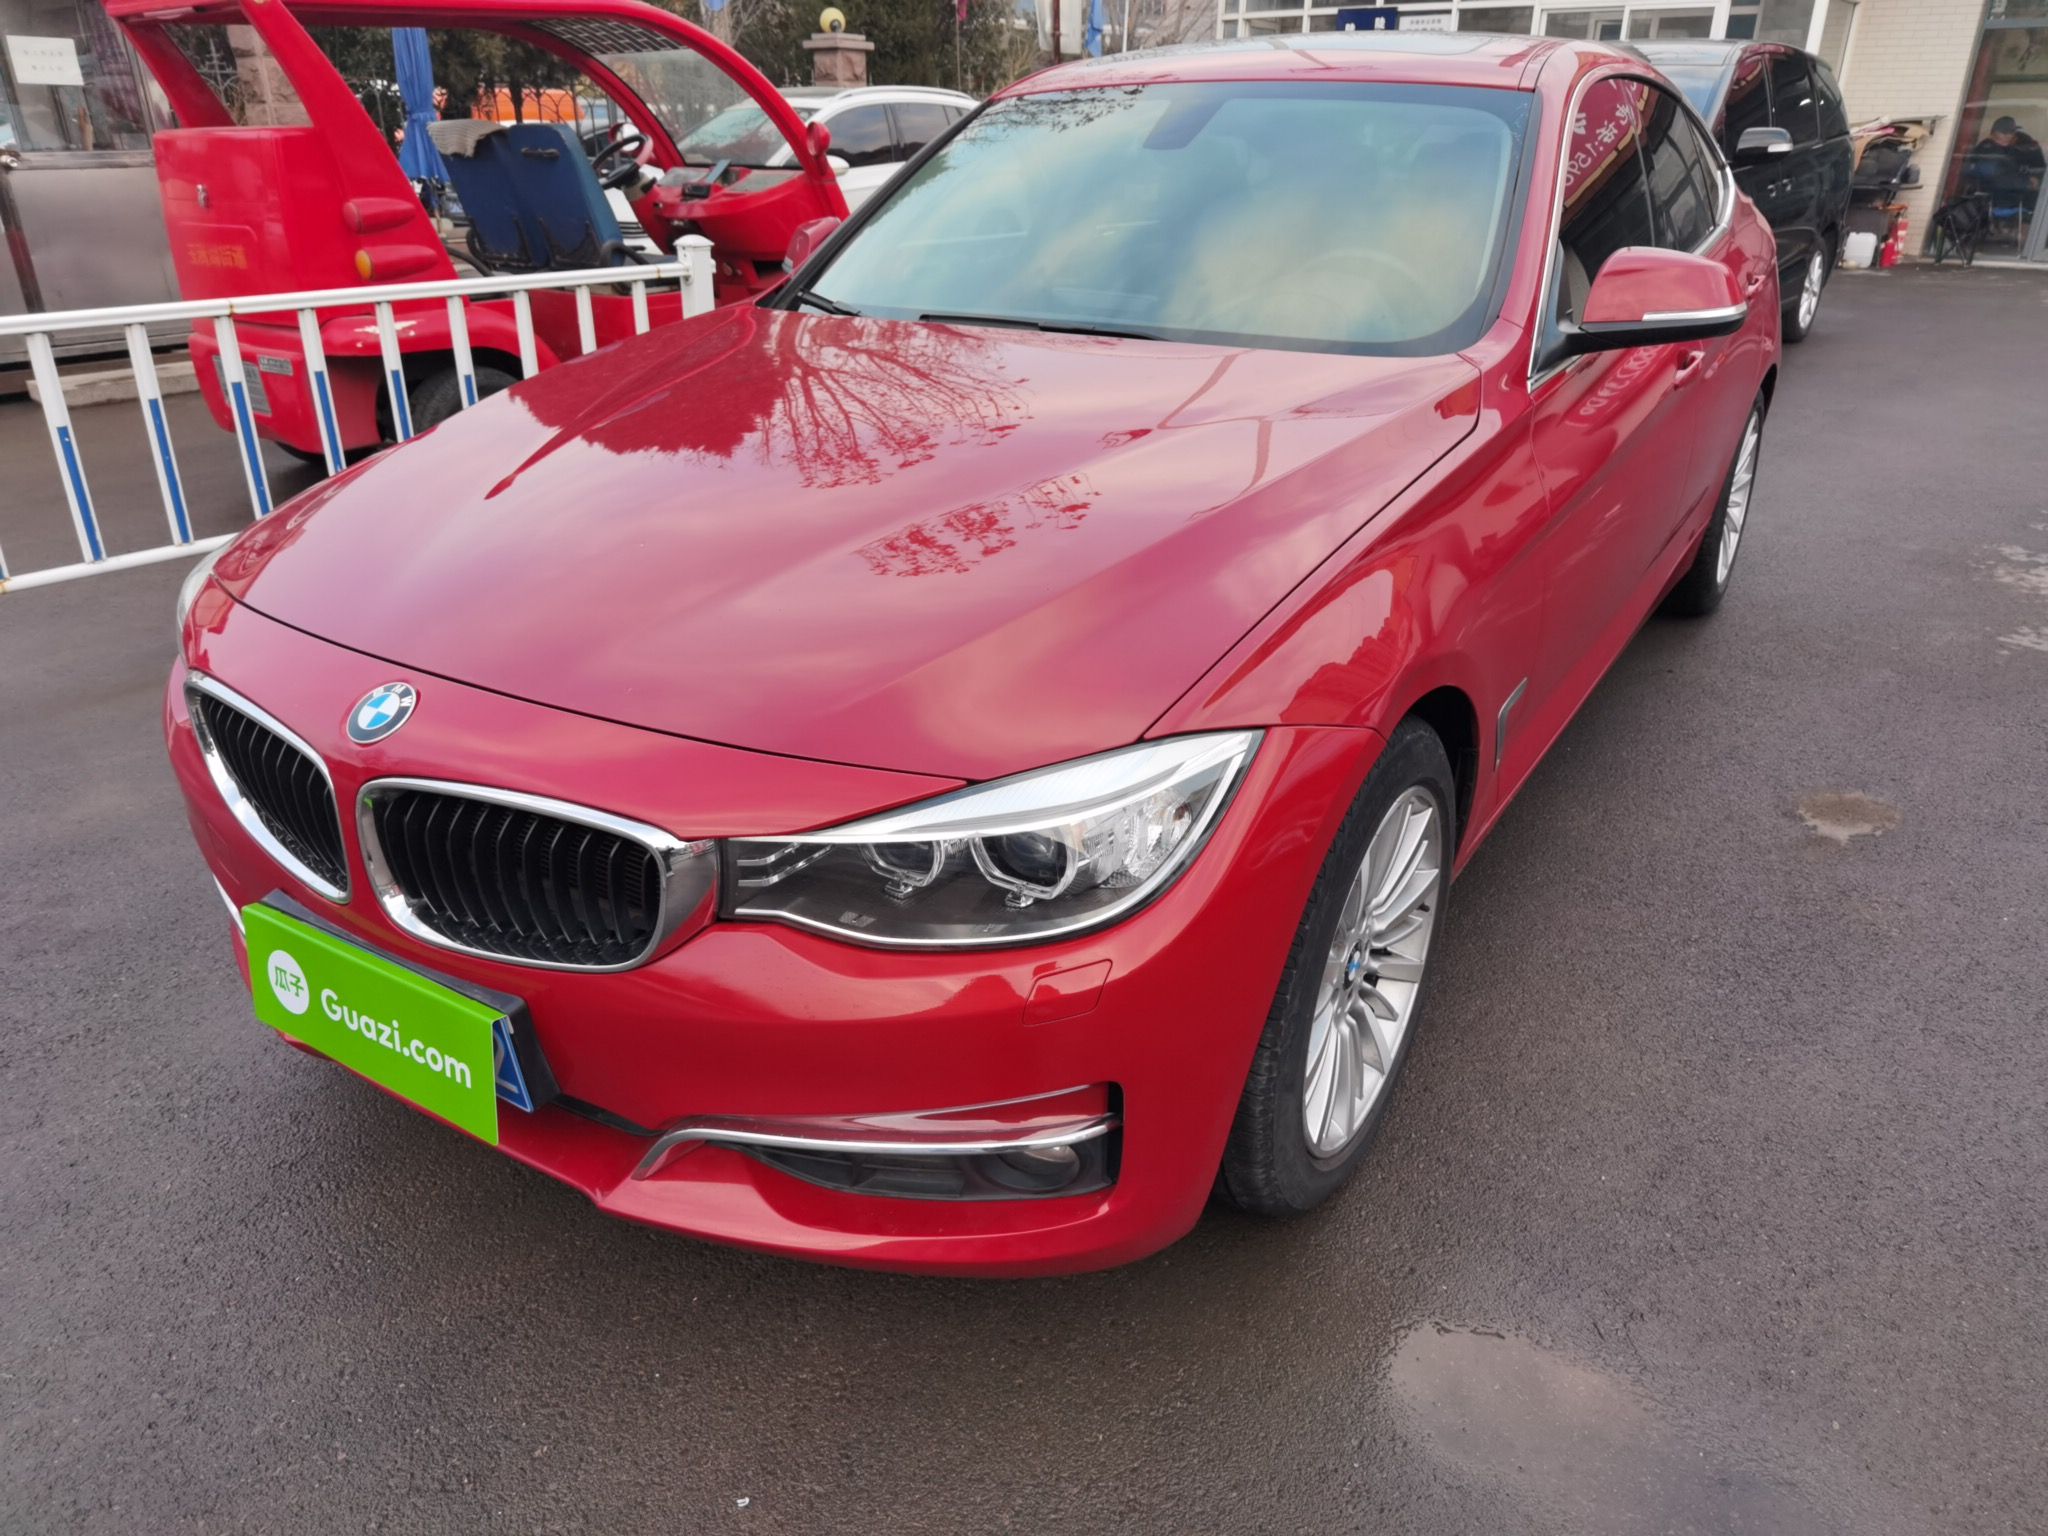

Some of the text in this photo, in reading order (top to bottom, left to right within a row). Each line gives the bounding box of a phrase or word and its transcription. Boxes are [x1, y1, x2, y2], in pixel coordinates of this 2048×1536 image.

[373, 683, 413, 707] BMW
[274, 965, 304, 998] 瓜子
[320, 987, 472, 1089] Guazi.com
